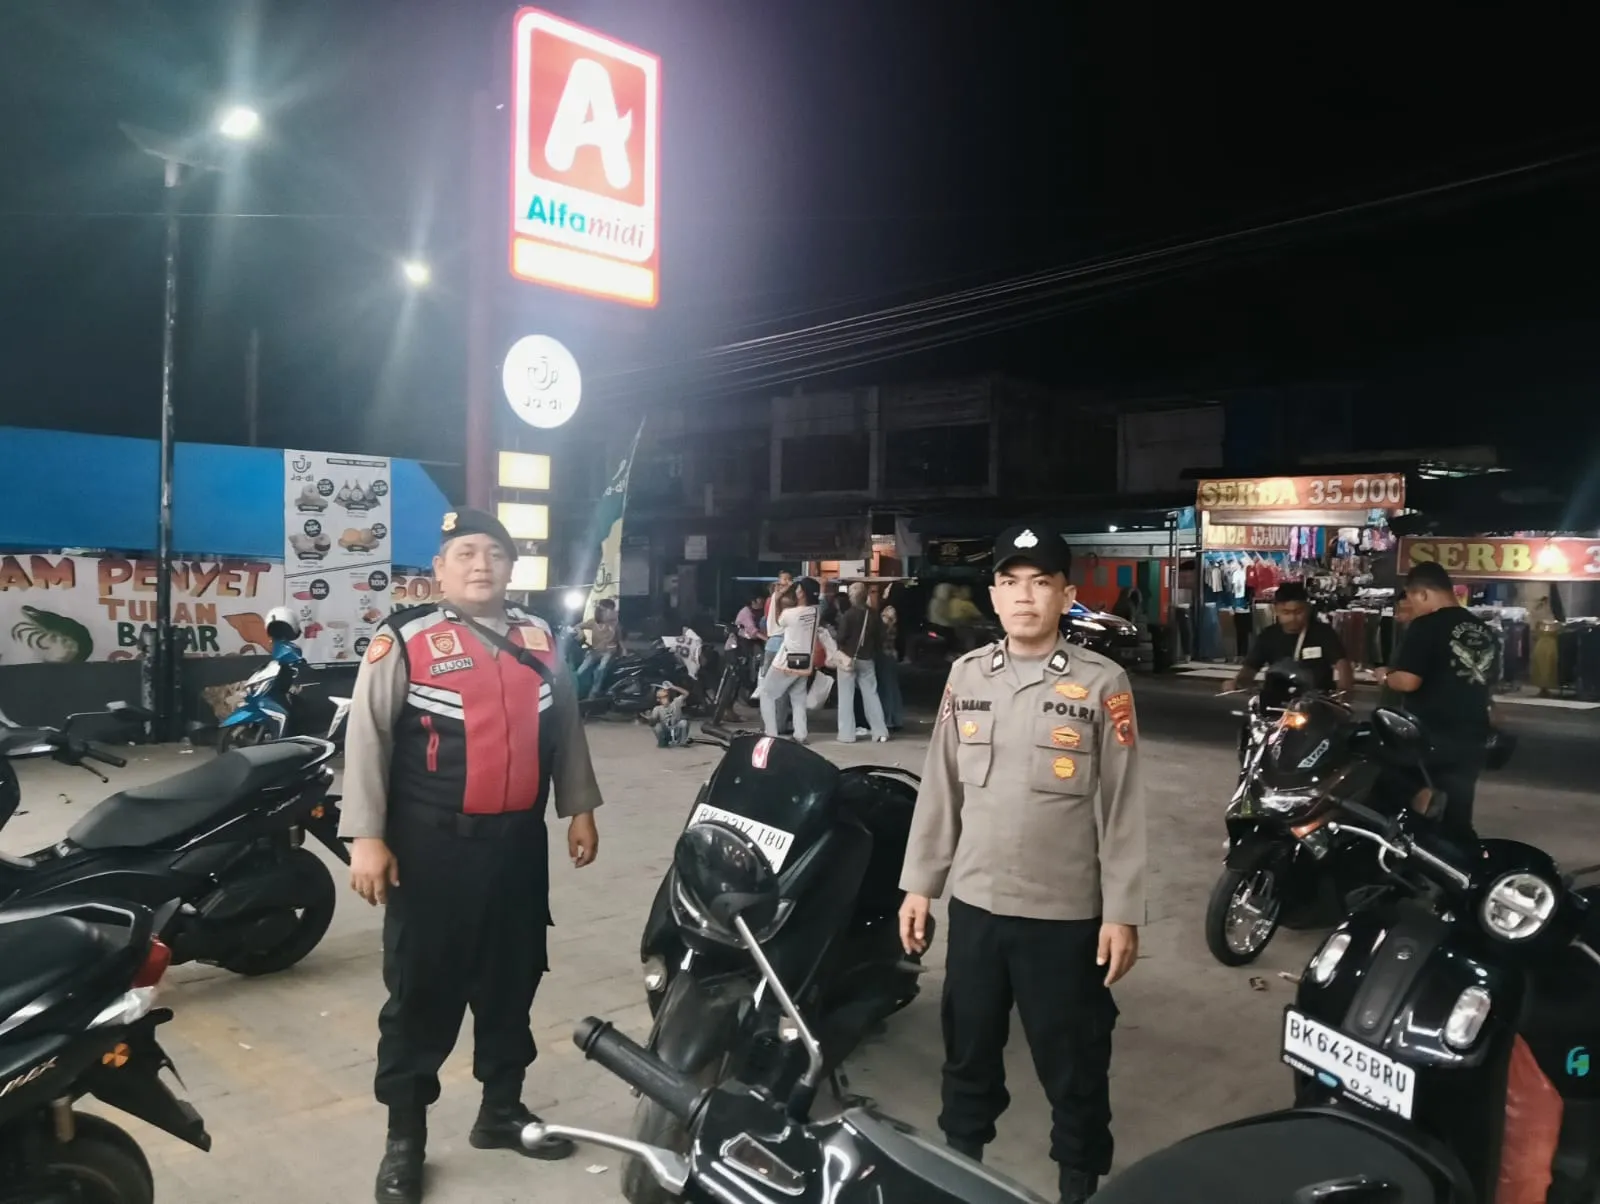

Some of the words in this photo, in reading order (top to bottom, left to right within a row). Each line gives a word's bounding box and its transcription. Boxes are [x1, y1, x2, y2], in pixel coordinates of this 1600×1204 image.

[526, 194, 646, 249] Alfamidi
[1201, 478, 1299, 506] SERBA
[1308, 478, 1400, 505] 35.000
[1408, 542, 1570, 574] SERBA
[98, 558, 271, 598] PENYET
[431, 658, 473, 674] ELIJON
[1043, 701, 1096, 722] POLRI
